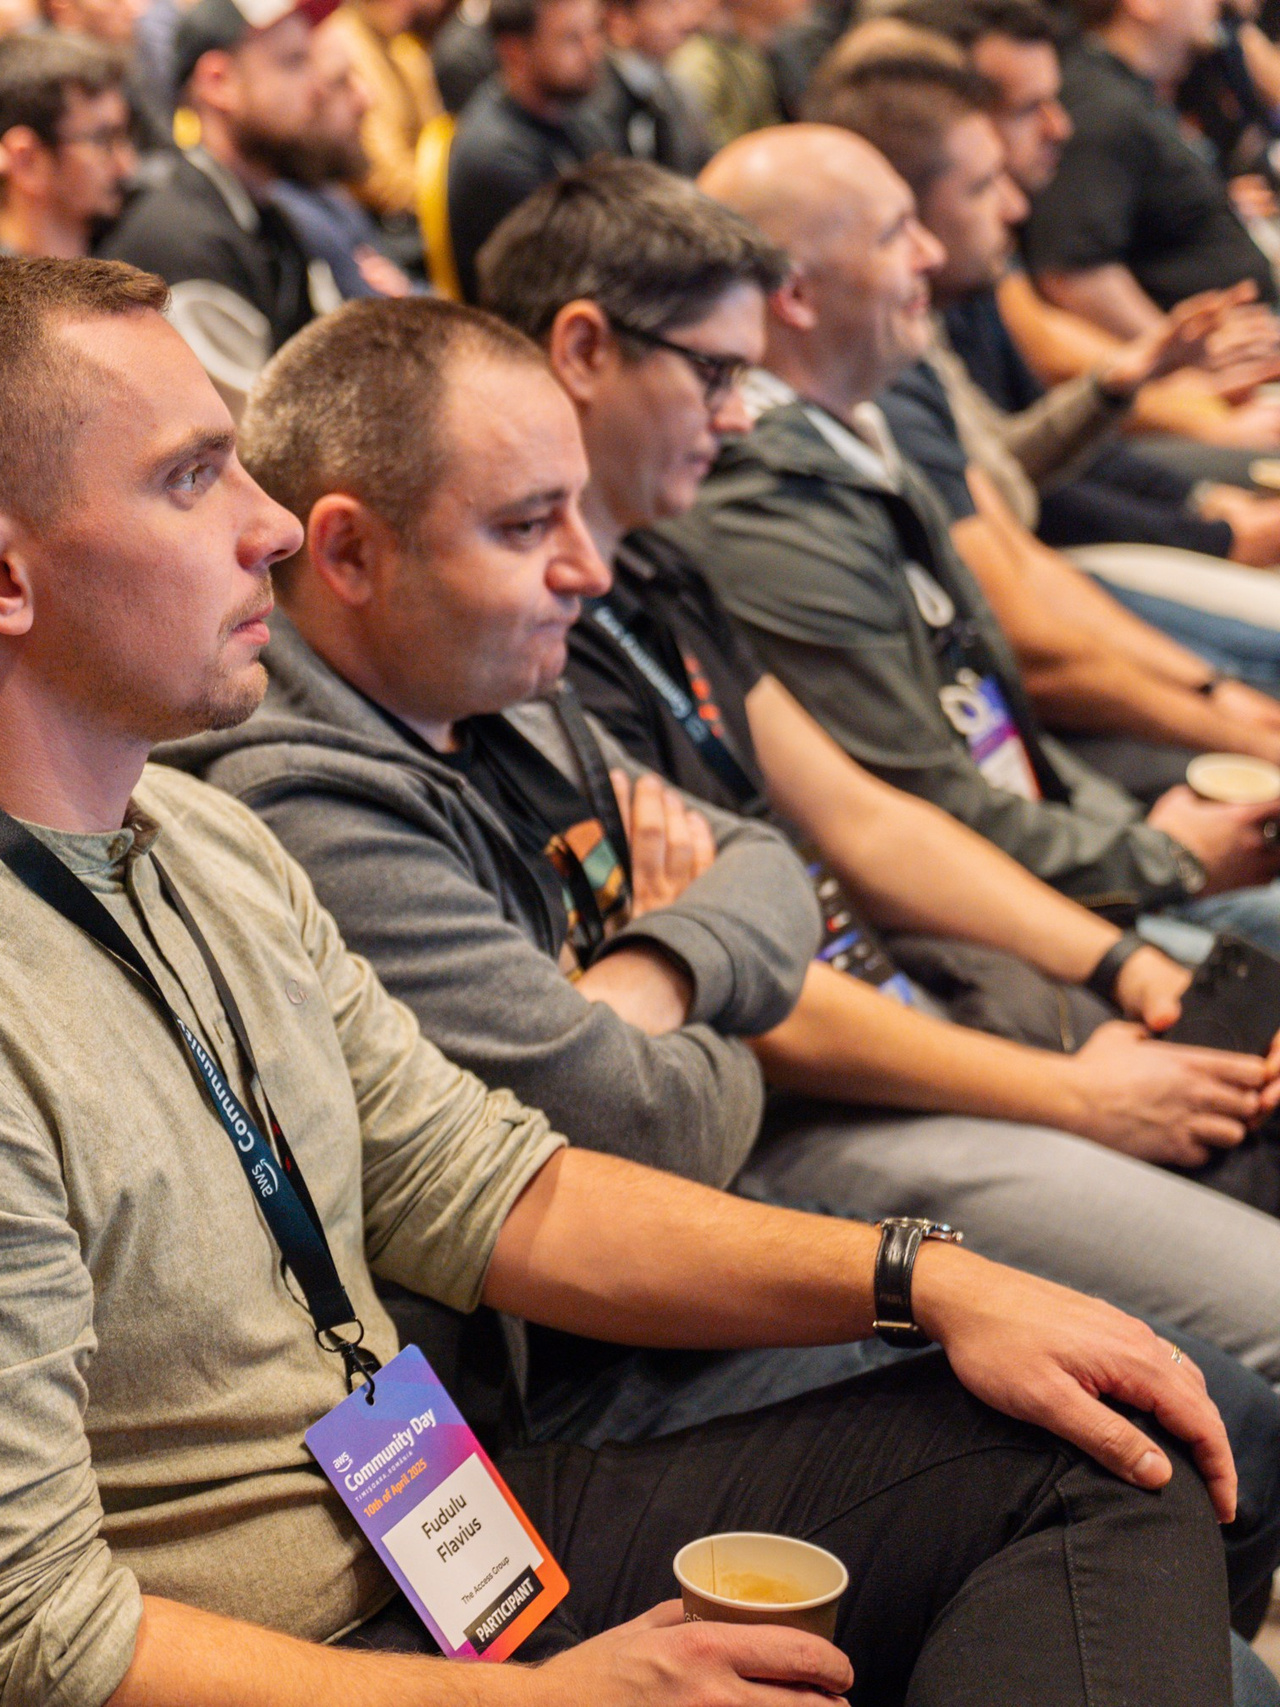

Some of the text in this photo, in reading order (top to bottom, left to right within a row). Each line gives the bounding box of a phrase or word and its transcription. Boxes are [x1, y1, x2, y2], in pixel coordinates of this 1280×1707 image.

[177, 1018, 274, 1198] aws Community
[332, 1451, 351, 1470] aws
[344, 1408, 437, 1492] Community Day
[363, 1457, 428, 1518] 10th of April 2025
[421, 1493, 467, 1540] Fudulu
[436, 1517, 482, 1563] Flavius
[461, 1556, 510, 1605] The Access Group
[475, 1577, 535, 1643] PARTICIPANT
